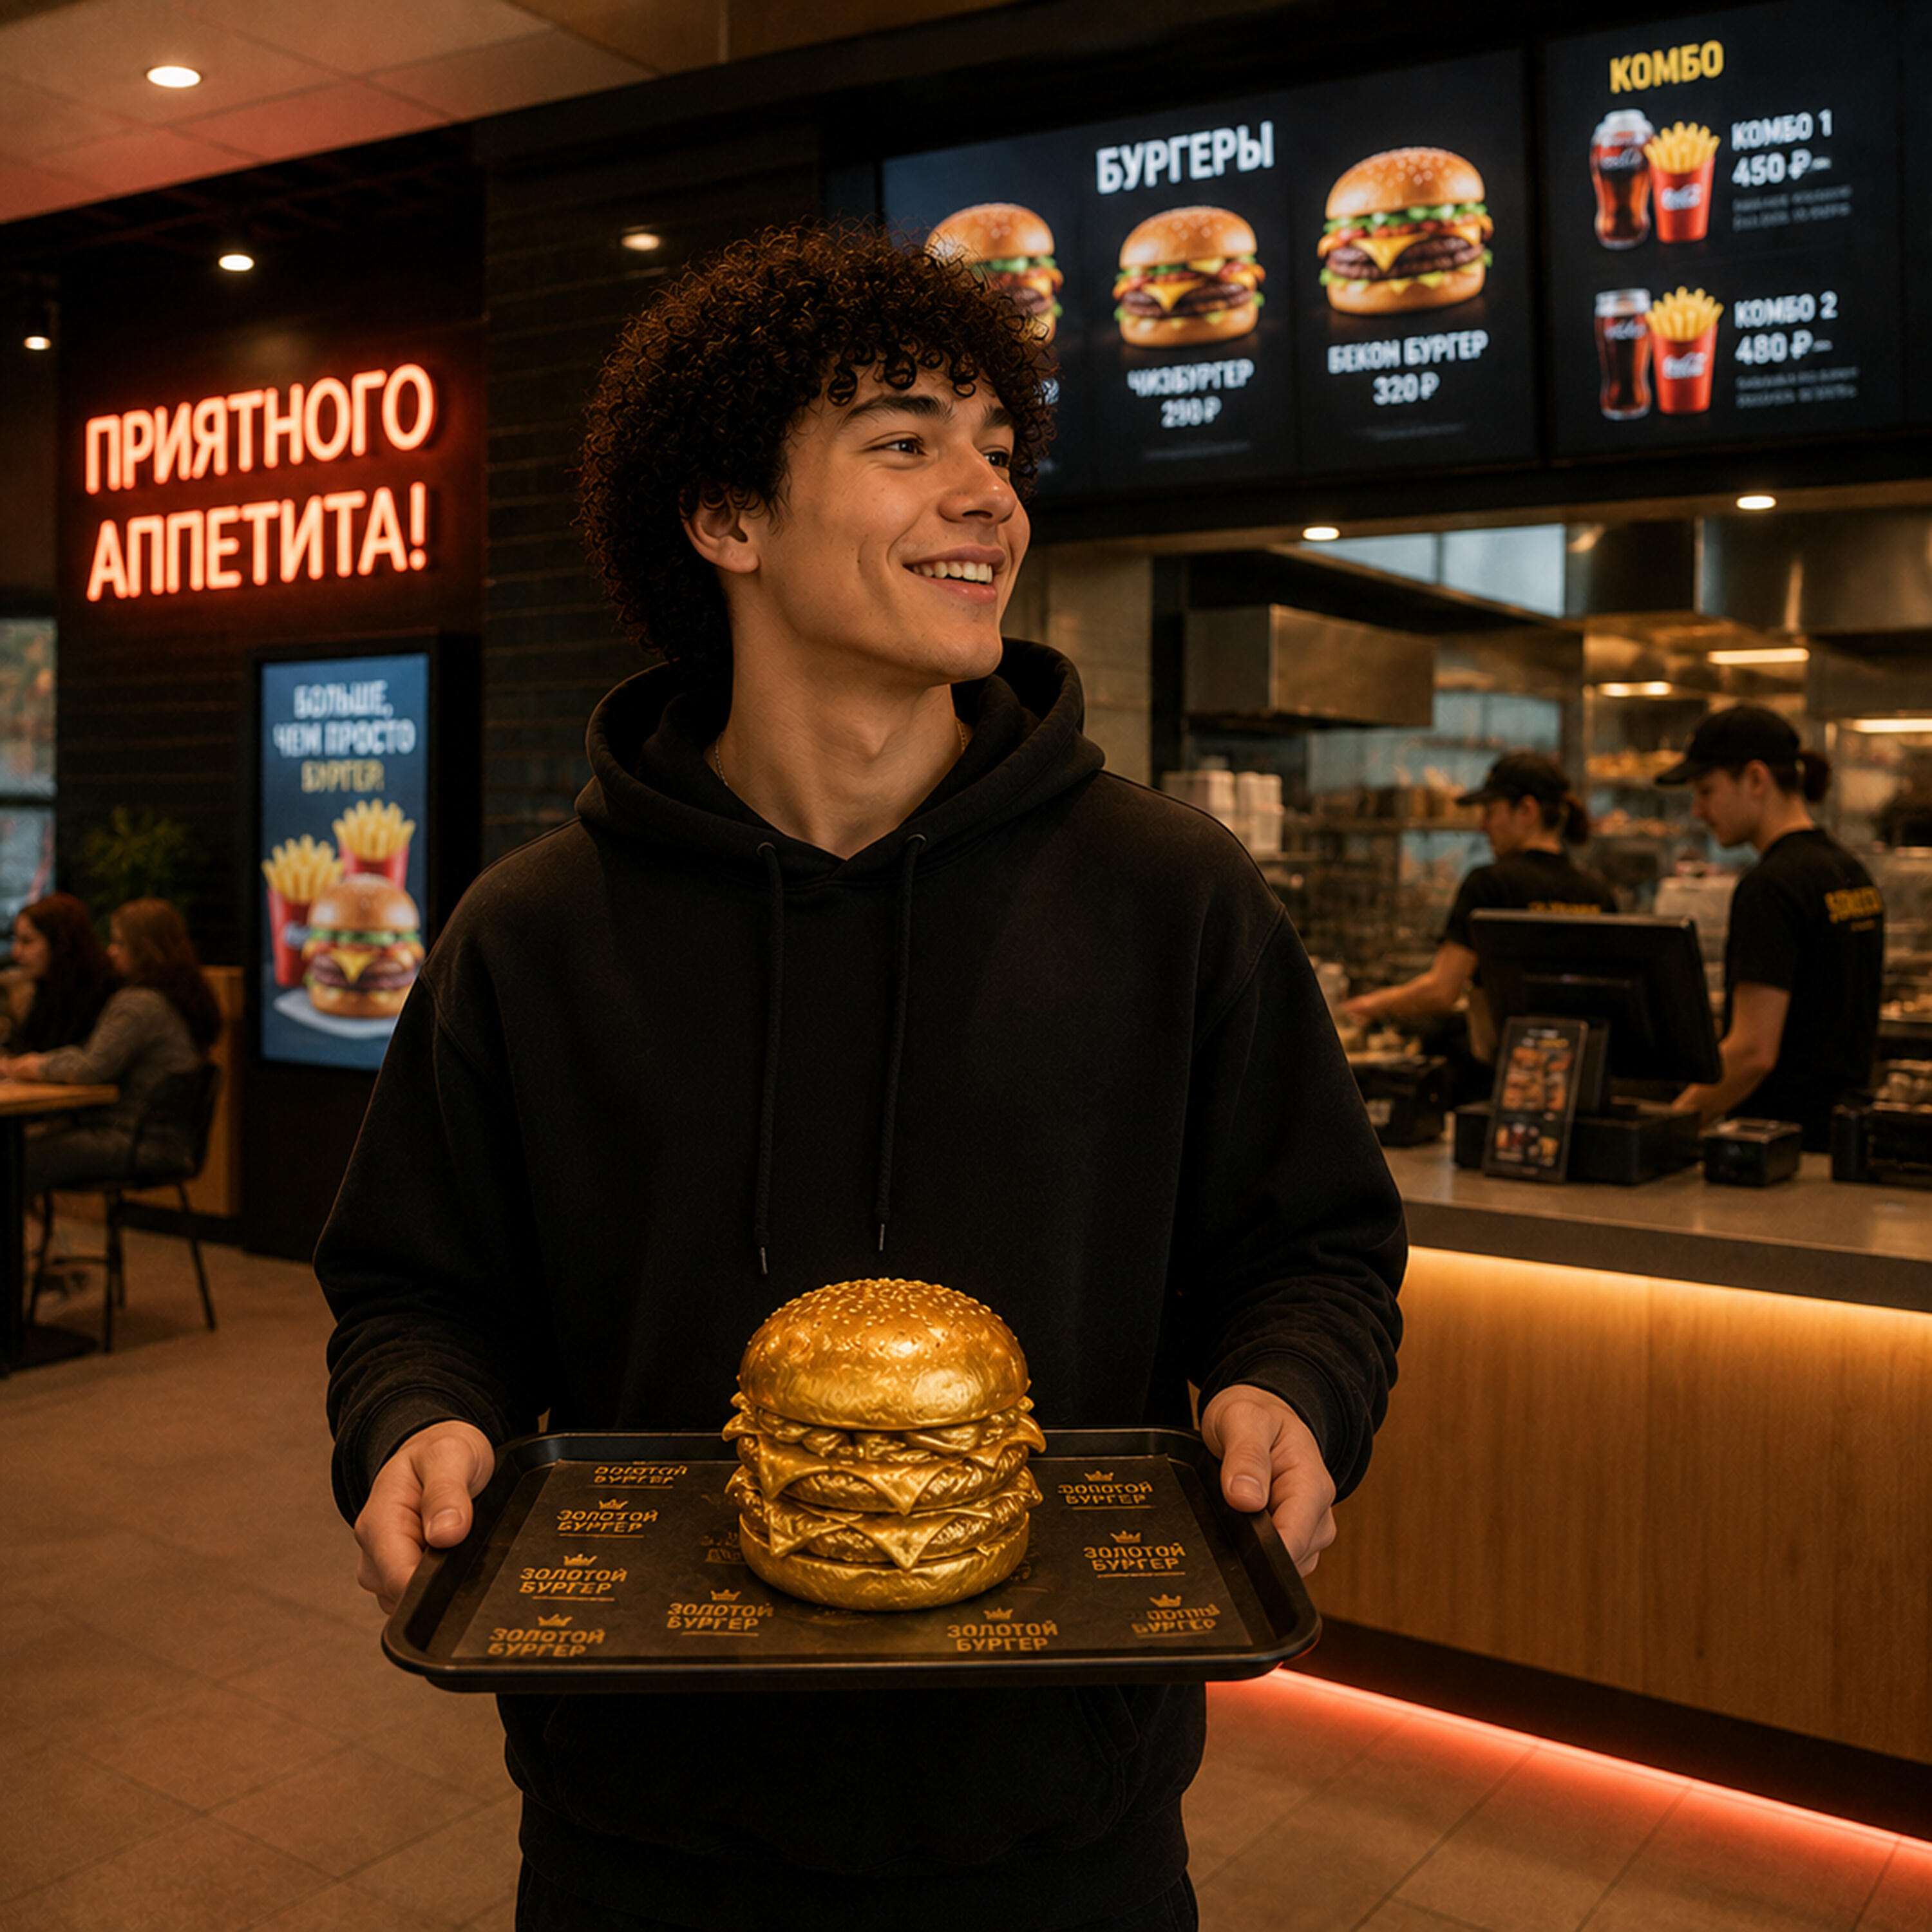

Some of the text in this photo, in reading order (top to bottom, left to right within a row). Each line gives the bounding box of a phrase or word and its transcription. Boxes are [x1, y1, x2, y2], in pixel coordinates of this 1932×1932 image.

[1610, 40, 1724, 94] КОМБО
[1731, 108, 1832, 151] КОМБО 1
[1096, 120, 1275, 194] БУРГЕРЫ
[1731, 152, 1786, 187] 450
[1734, 290, 1839, 329] КОМБО 2
[1403, 328, 1490, 366] БУРГЕР
[1734, 332, 1788, 365] 480
[85, 363, 435, 495] ПРИЯТНОГО
[86, 481, 427, 602] АППЕТИТА!
[273, 718, 416, 757] ЧЕМ ПРОСТО
[1083, 1542, 1186, 1558] ЗОЛОТОЙ
[519, 1581, 612, 1594] БУРГЕР
[520, 1567, 628, 1582] ЗОЛОТОЙ
[666, 1616, 759, 1631] БУРГЕР
[667, 1602, 774, 1618] ЗОЛОТОЙ
[488, 1627, 606, 1644] ЗОЛОТОЙ
[947, 1620, 1058, 1638] ЗОЛОТОЙ
[956, 1637, 1048, 1652] БУРГЕР
[487, 1642, 587, 1657] БУРГЕР
